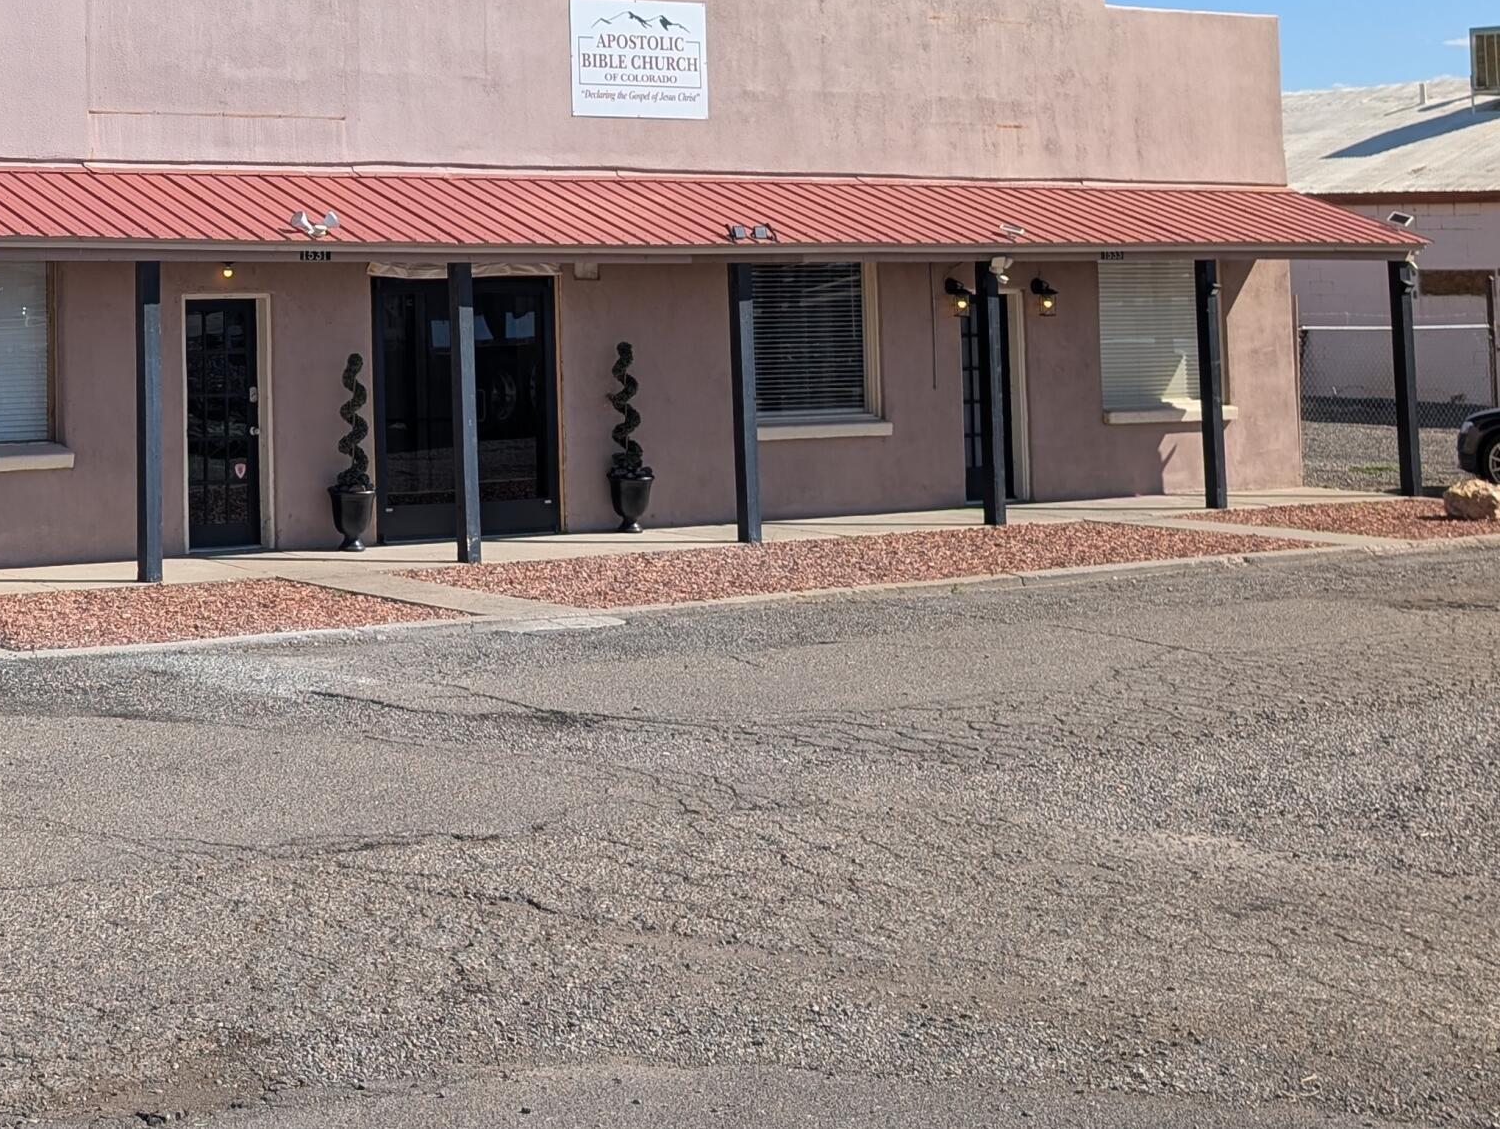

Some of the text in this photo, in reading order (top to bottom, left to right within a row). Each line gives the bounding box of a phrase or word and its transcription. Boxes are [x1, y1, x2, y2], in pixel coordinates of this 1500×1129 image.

[596, 33, 684, 52] APOSTOLIC
[582, 53, 698, 72] BIBLE CHURCH
[604, 73, 677, 84] OF COLORADO
[617, 90, 628, 100] the
[629, 91, 650, 103] Gospel
[651, 92, 660, 103] of
[659, 92, 676, 102] Jesus
